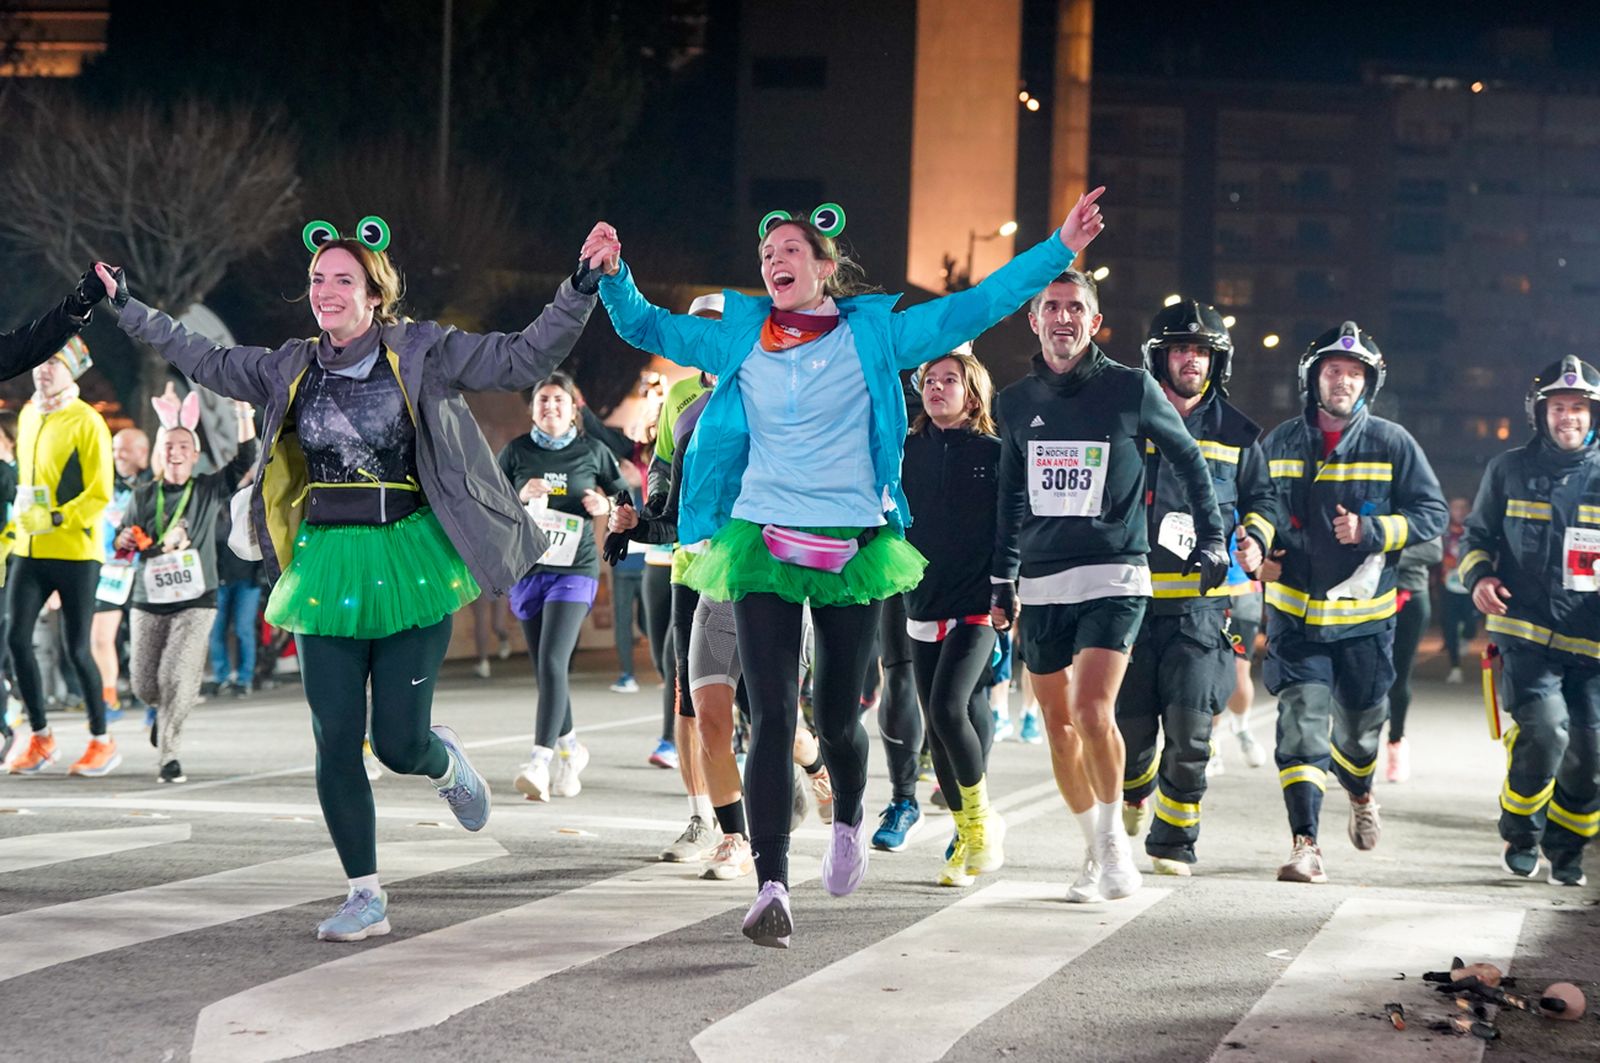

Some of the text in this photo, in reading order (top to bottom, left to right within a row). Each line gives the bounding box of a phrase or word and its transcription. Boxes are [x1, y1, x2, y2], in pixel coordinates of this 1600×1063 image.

[1045, 449, 1079, 457] NOCHE DE
[1036, 458, 1052, 467] SAN
[1042, 468, 1092, 490] 3083
[154, 569, 193, 588] 5309
